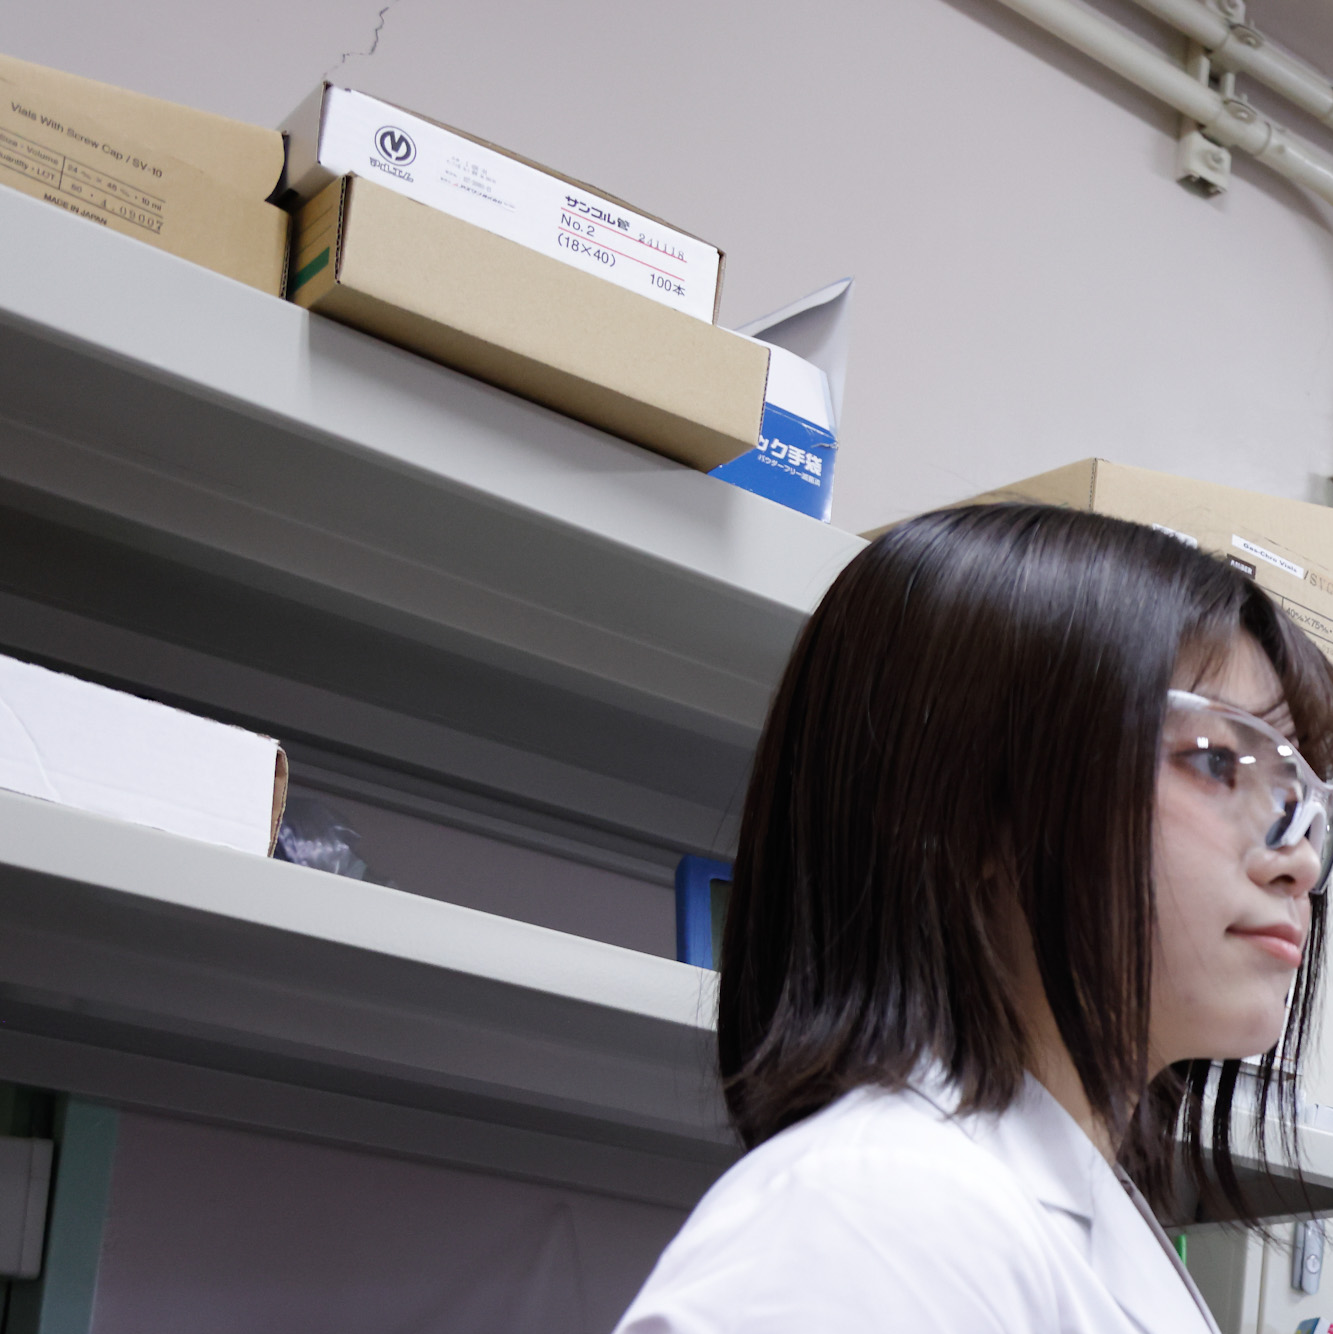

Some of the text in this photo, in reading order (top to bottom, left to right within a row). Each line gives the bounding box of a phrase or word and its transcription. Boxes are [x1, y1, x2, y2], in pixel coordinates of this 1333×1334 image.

[11, 101, 37, 121] Vials
[40, 115, 64, 133] With
[67, 128, 99, 149] Screw
[102, 143, 123, 161] Cap
[43, 193, 108, 226] MADE IN JAPAN
[650, 273, 686, 296] 100本
